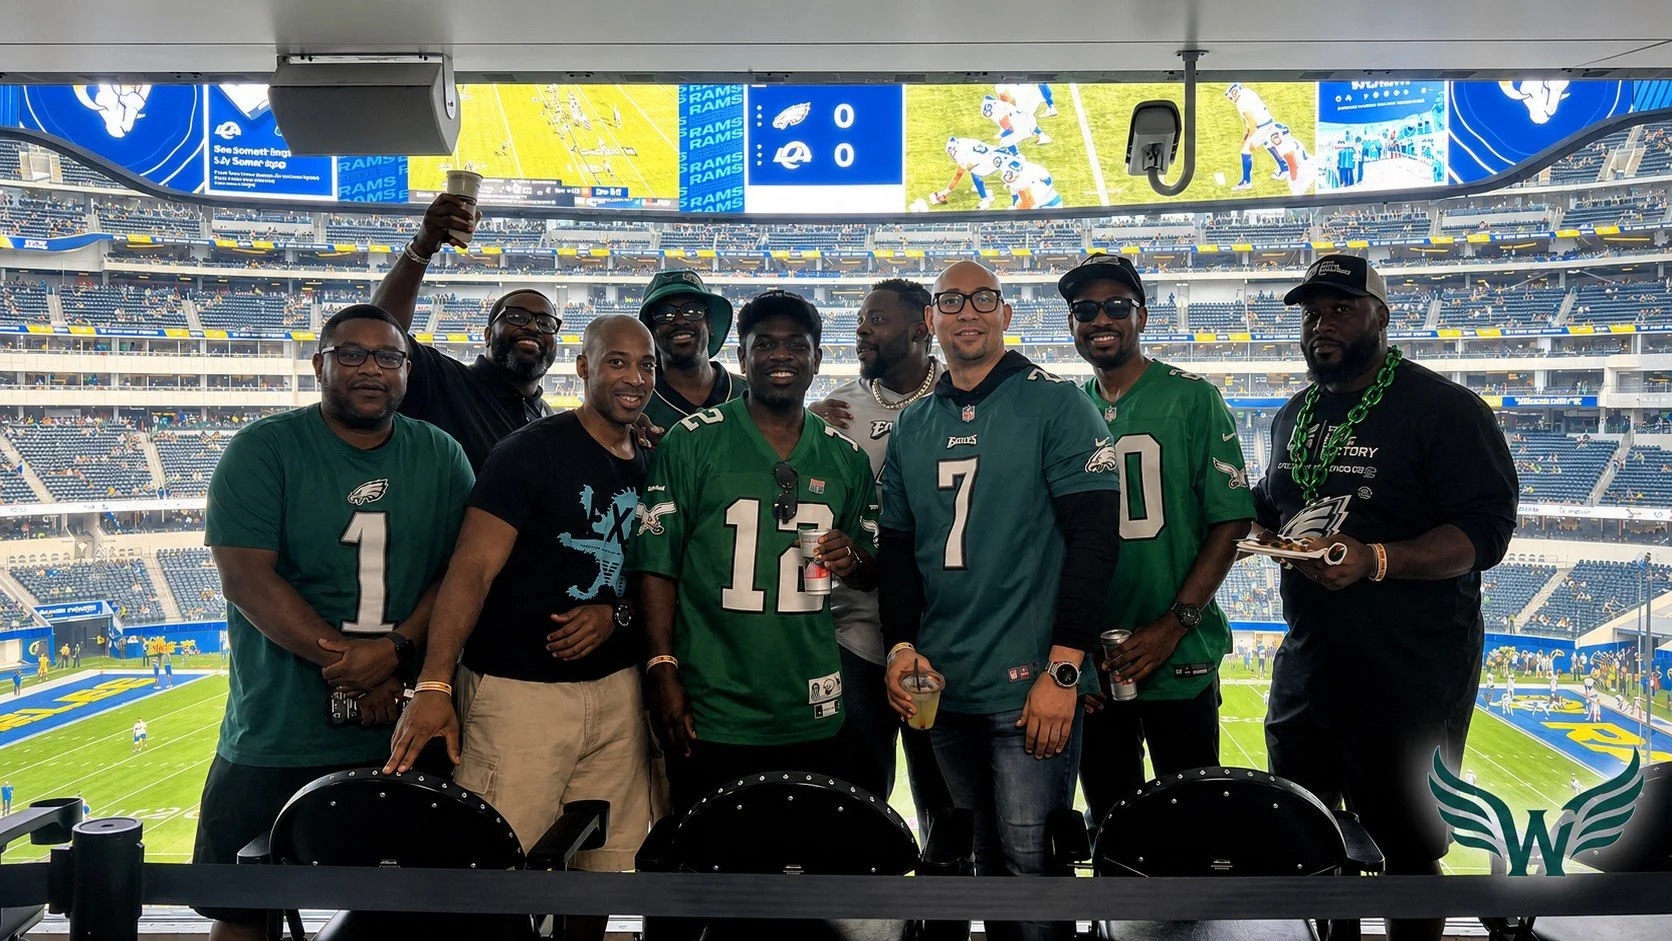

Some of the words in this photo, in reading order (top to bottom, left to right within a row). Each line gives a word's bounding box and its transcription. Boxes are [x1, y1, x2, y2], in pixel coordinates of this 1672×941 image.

[689, 94, 743, 116] RAMS
[833, 103, 855, 129] 0
[689, 117, 743, 138] RAMS
[689, 129, 744, 150] RAMS
[689, 152, 743, 174] RAMS
[833, 142, 855, 168] 0
[689, 163, 743, 186] RAMS
[338, 176, 397, 197] RAMS
[690, 186, 744, 208] RAMS
[936, 455, 981, 572] 7
[721, 497, 837, 614] 12
[338, 511, 398, 635] 1
